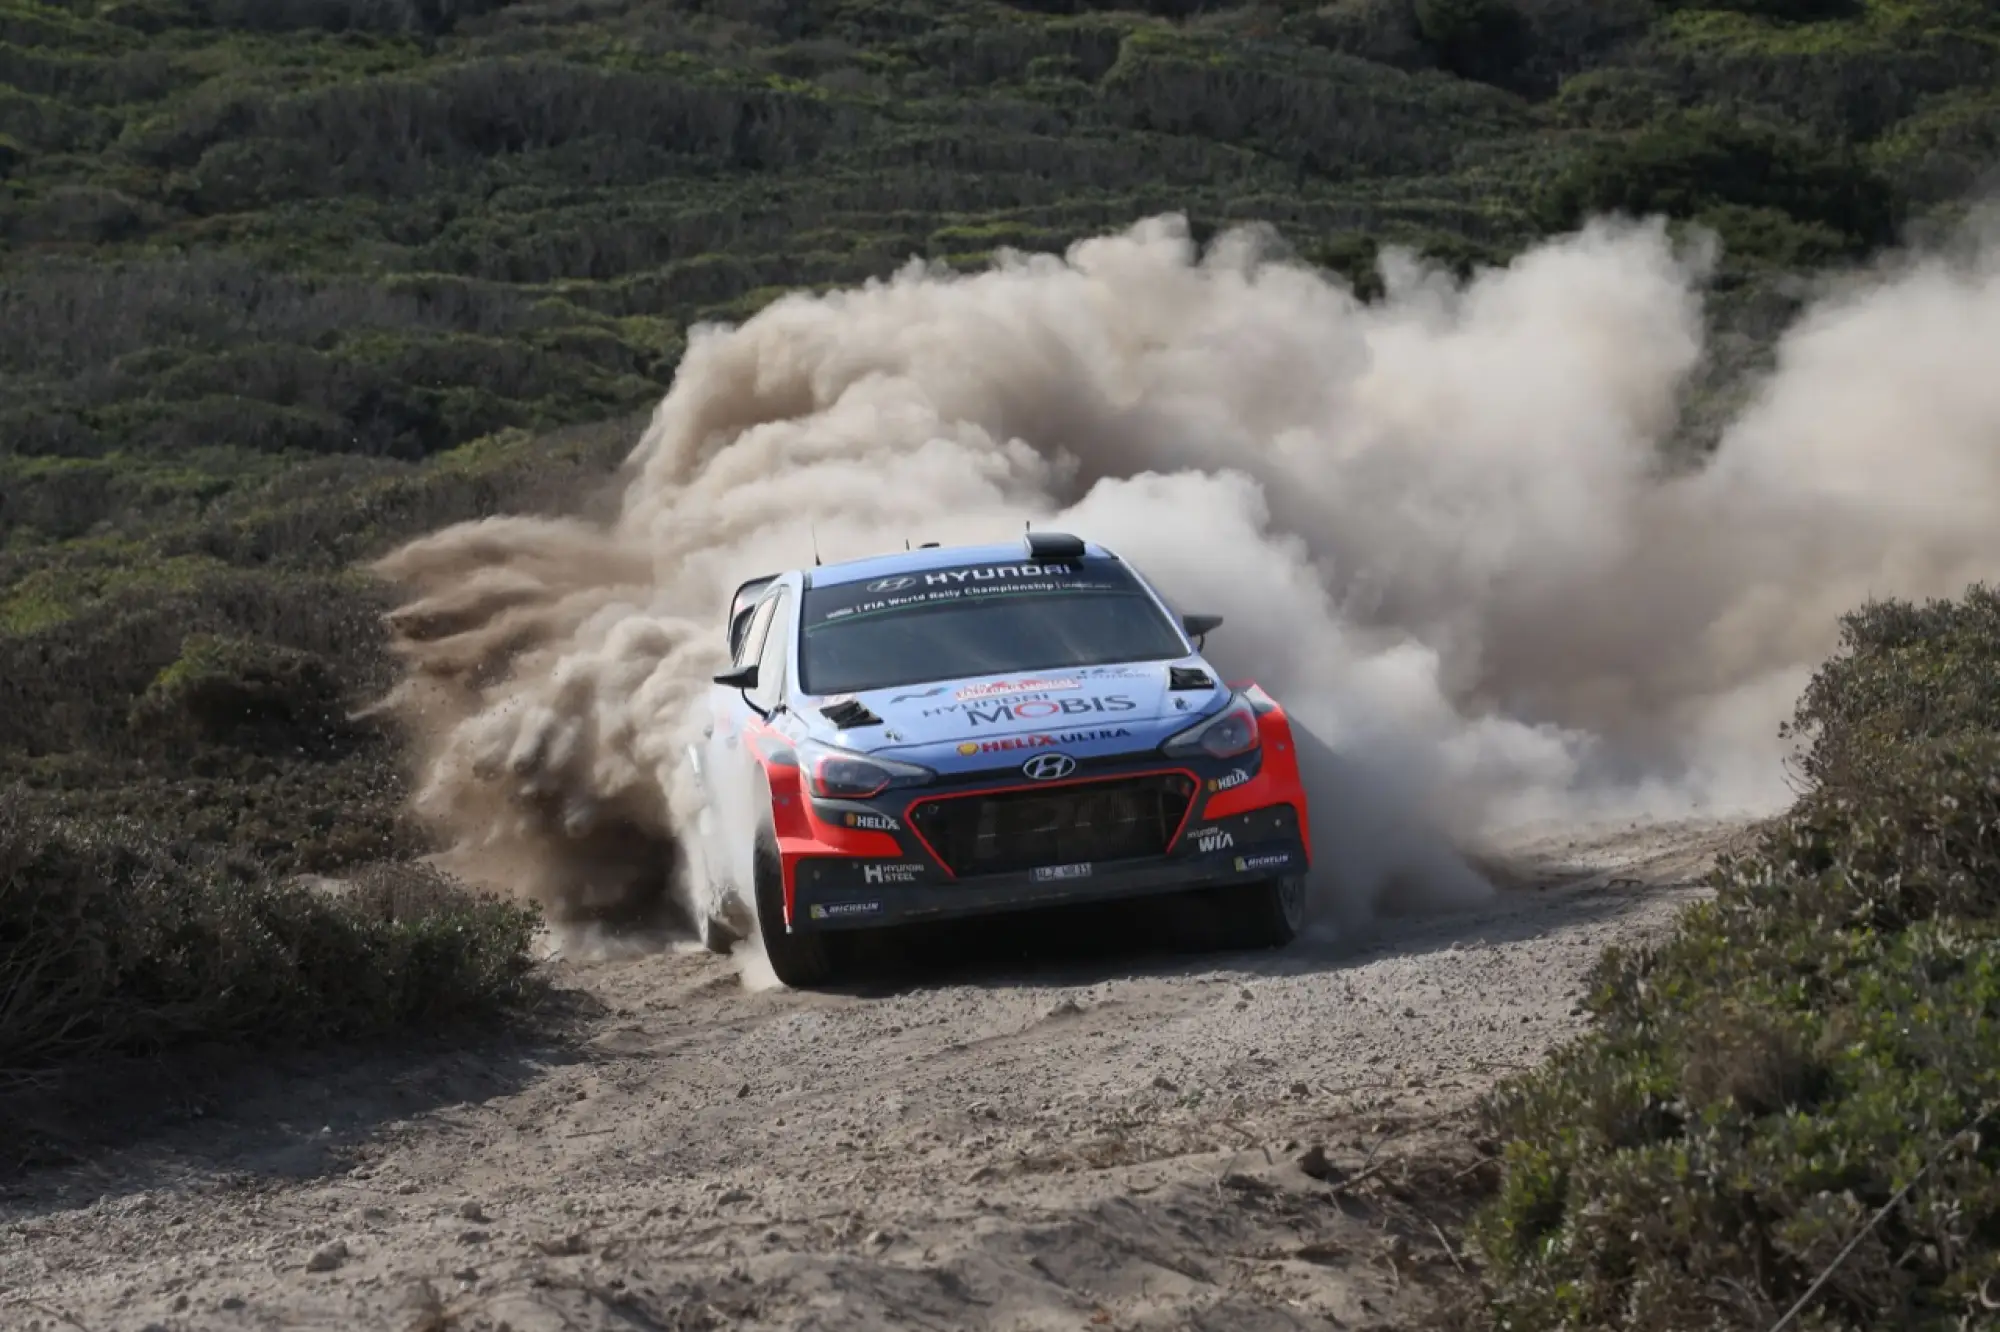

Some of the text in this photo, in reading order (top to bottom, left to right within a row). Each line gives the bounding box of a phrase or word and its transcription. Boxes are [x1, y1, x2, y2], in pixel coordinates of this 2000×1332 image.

[924, 563, 1072, 585] HYUNDAI
[863, 600, 885, 611] FIA
[888, 593, 926, 606] World
[929, 588, 961, 601] Rally
[964, 581, 1054, 596] Championship
[922, 692, 1049, 718] HYUNDAI
[966, 694, 1137, 726] MOBIS
[982, 728, 1131, 753] HELIX ULTRA
[1217, 768, 1249, 790] HELIX
[857, 815, 900, 830] HELIX
[1248, 853, 1289, 867] MICHELIN
[829, 902, 879, 914] MICHELIN
